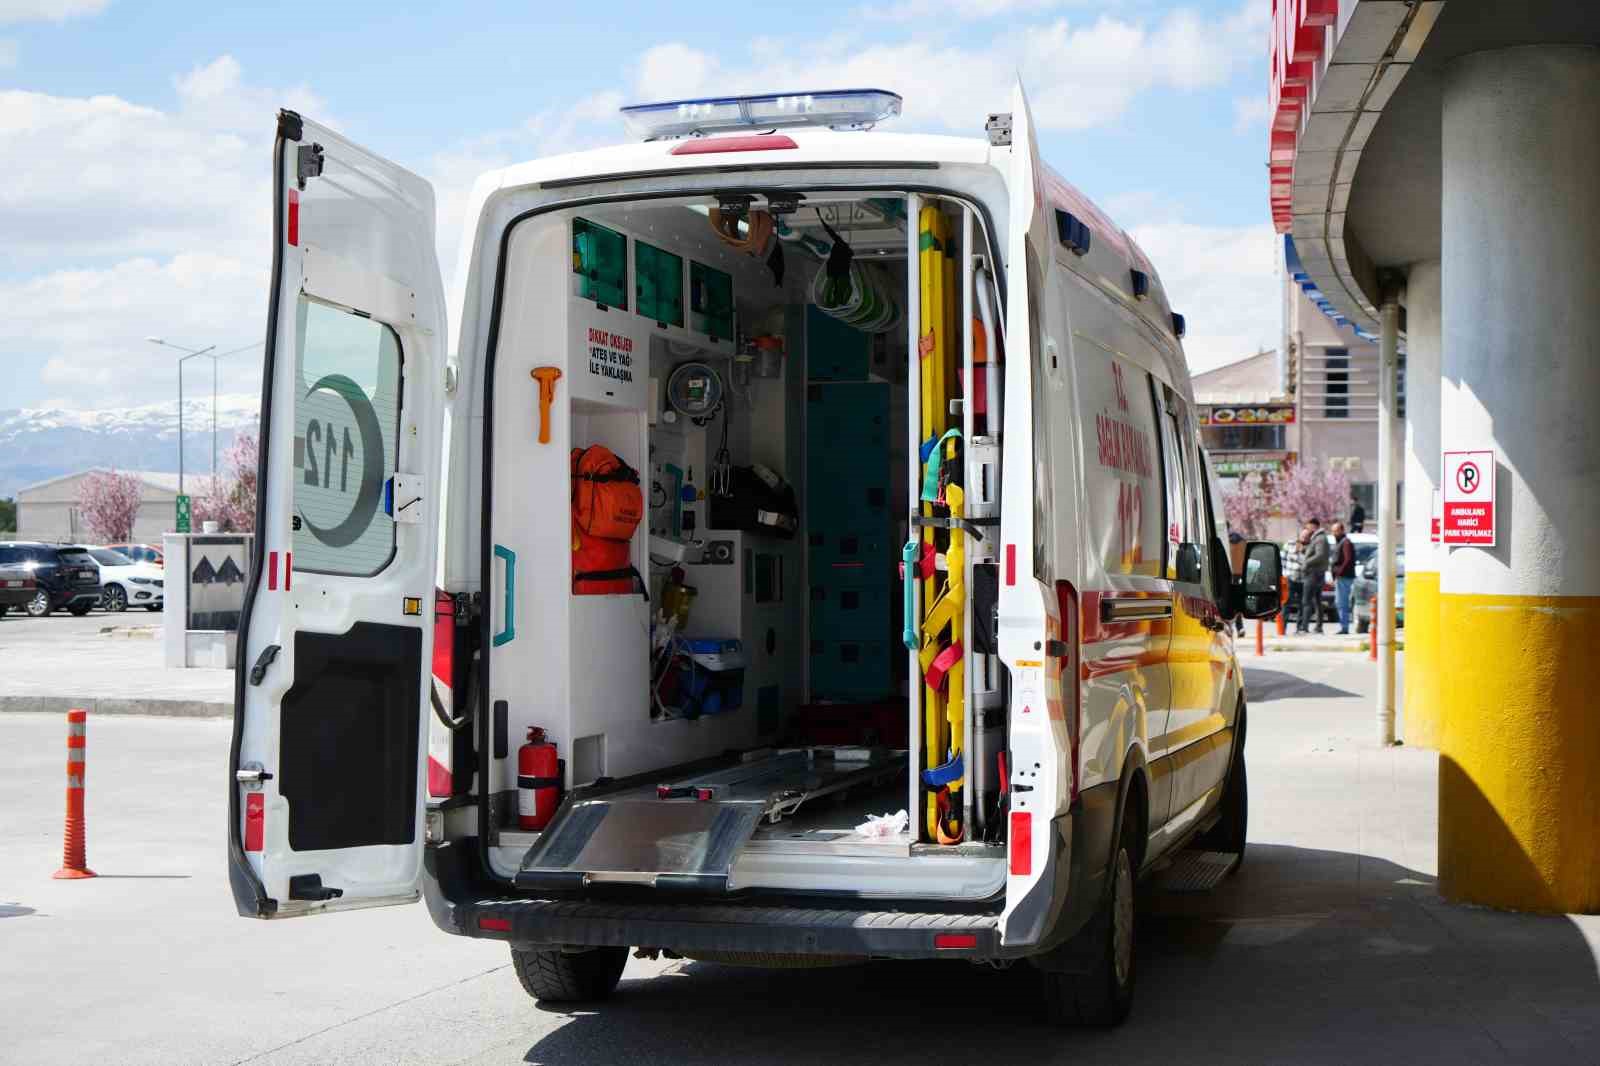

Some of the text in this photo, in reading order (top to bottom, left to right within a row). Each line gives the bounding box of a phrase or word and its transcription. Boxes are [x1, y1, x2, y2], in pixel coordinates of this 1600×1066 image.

[609, 350, 617, 364] VE
[589, 359, 600, 375] İLE
[1450, 507, 1486, 516] AMBULANS
[1444, 529, 1461, 537] PARK
